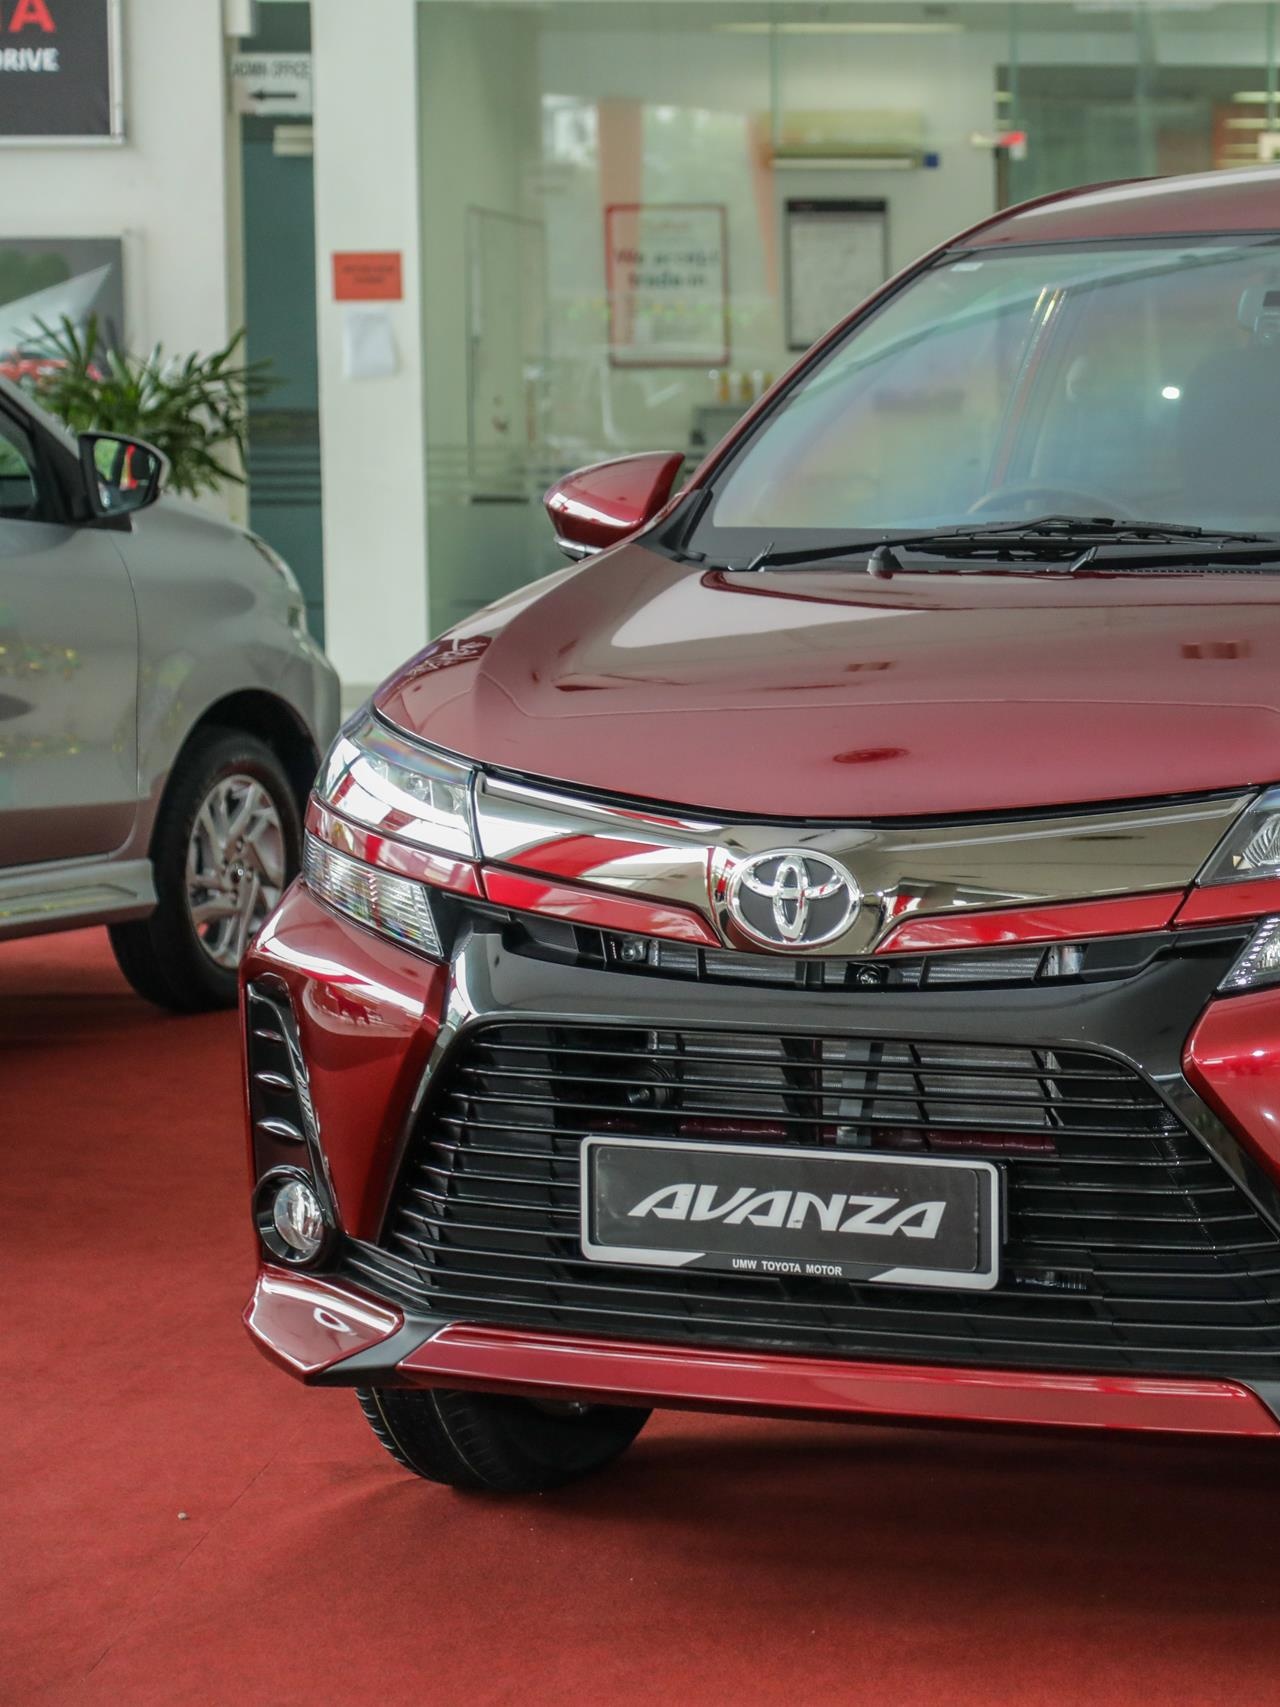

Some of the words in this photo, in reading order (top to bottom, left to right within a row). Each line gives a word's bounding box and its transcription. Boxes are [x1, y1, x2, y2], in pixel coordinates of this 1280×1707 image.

[0, 47, 59, 72] RIVE
[627, 1183, 947, 1239] AVANZA
[732, 1258, 758, 1270] UMW
[761, 1260, 802, 1273] TOYOTA
[805, 1263, 843, 1277] MOTOR
